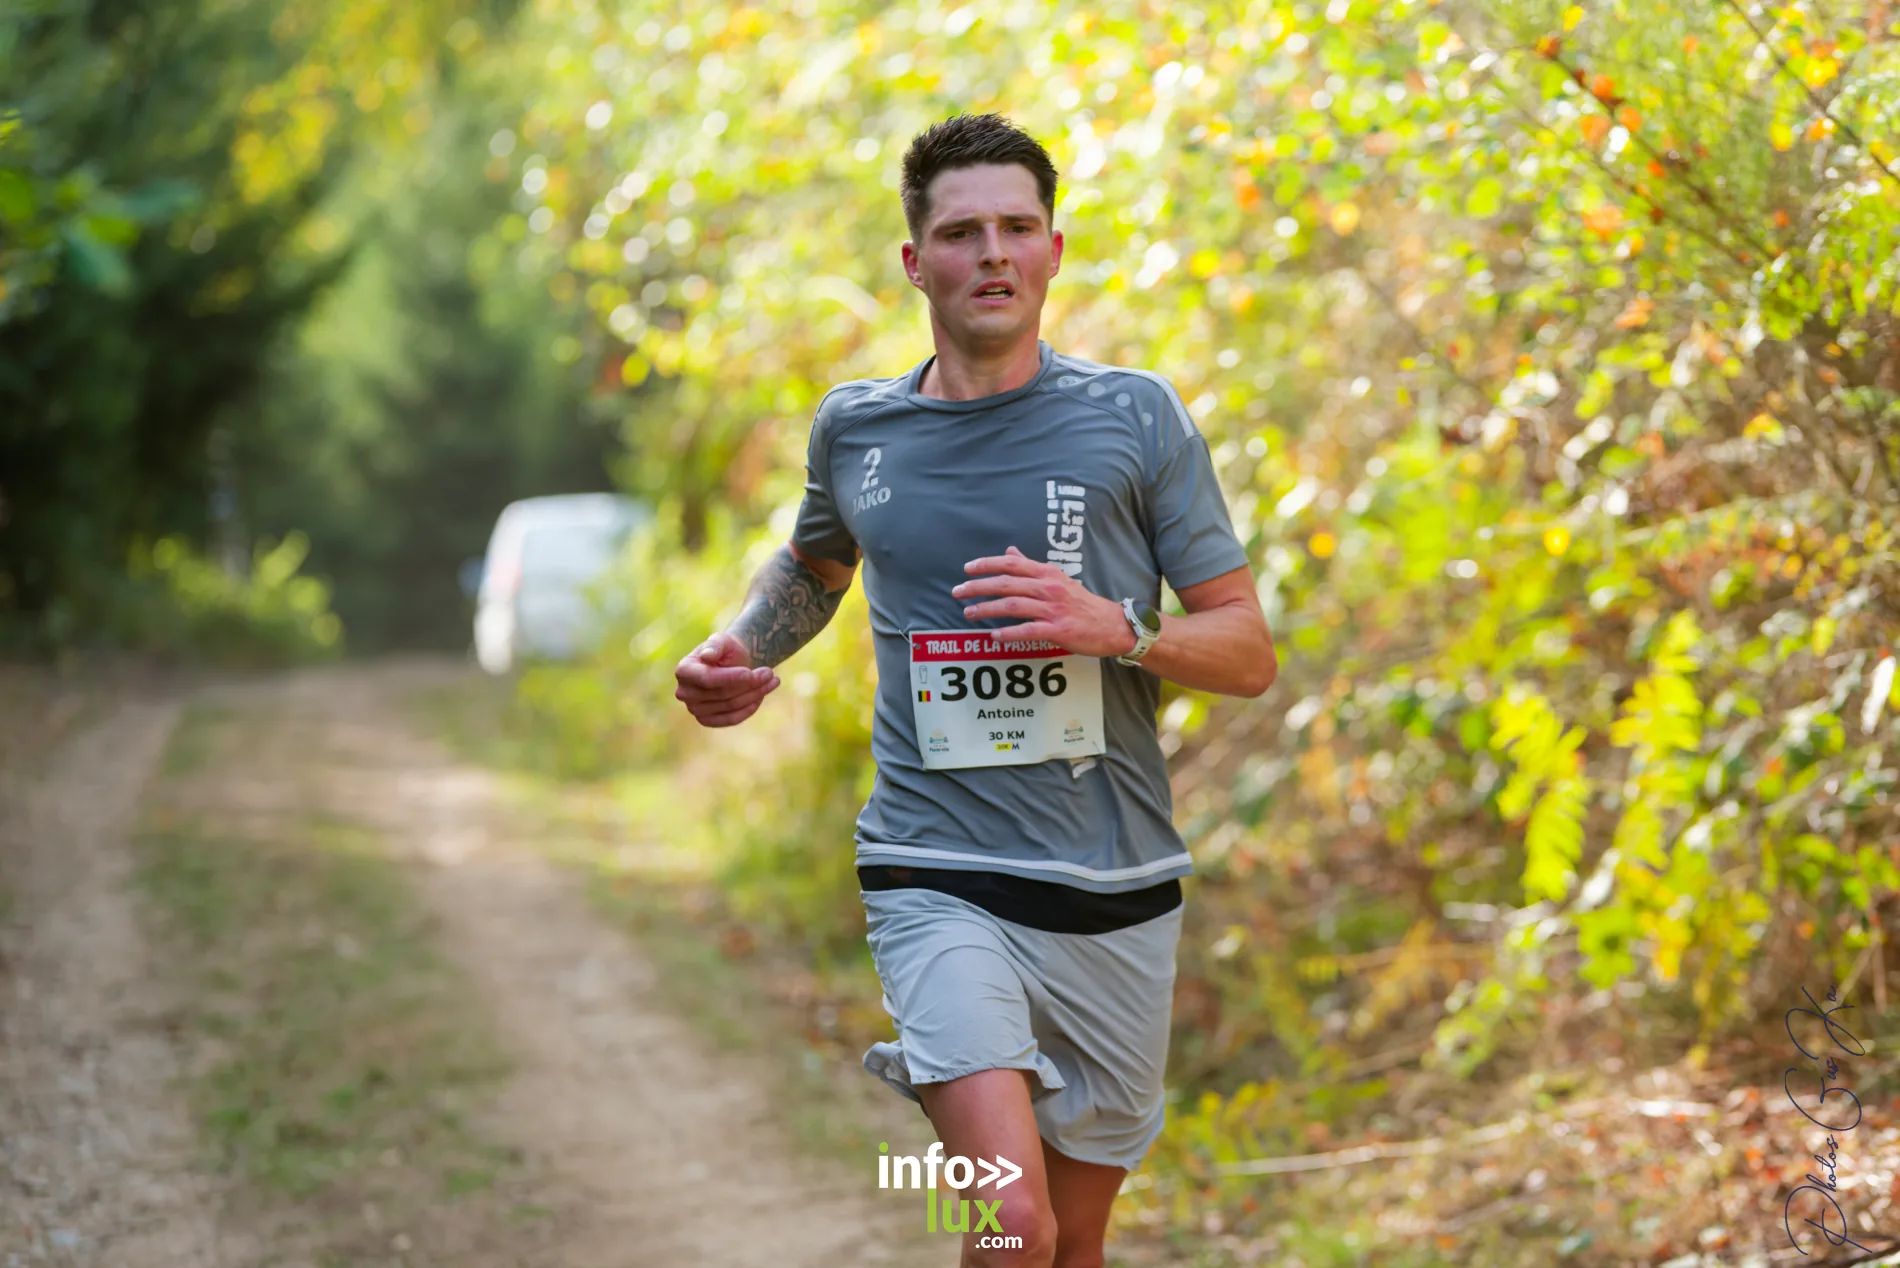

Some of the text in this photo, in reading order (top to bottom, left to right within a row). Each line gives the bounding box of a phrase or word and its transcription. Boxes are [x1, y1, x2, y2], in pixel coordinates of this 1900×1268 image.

[852, 487, 891, 516] JAKO
[925, 640, 961, 655] TRAIL
[964, 639, 981, 653] DE
[984, 639, 1001, 653] LA
[940, 661, 1067, 702] 3086
[977, 707, 1035, 720] Antoine
[989, 730, 1025, 741] 30 KM
